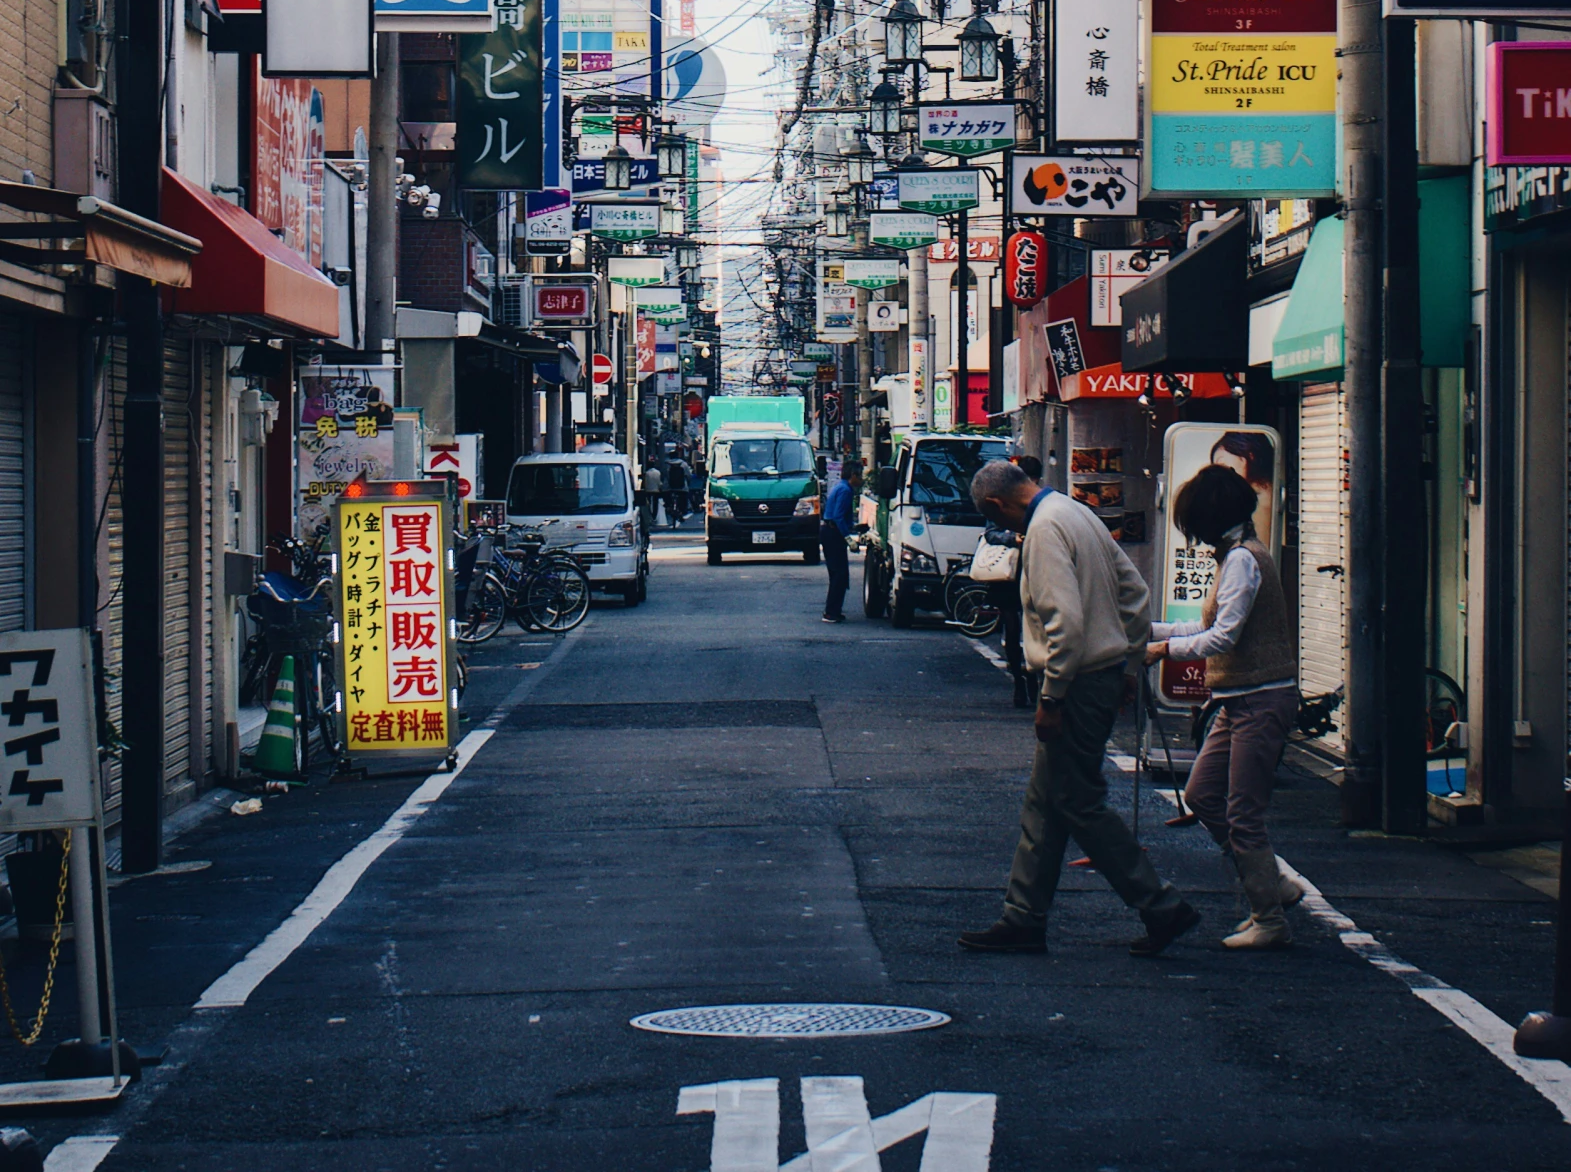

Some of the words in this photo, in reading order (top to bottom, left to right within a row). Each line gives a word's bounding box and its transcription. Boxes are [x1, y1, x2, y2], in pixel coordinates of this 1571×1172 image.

[1206, 7, 1283, 16] SHINSAIBASHI
[1192, 41, 1219, 51] Total
[1221, 41, 1268, 51] Treatment
[1272, 41, 1297, 51] salon
[1086, 26, 1110, 98] 心斎橋
[1277, 65, 1317, 80] ICU
[1015, 237, 1038, 300] たこ焼
[325, 396, 366, 411] bag
[316, 416, 378, 438] 免税
[319, 458, 376, 474] jewelry
[309, 483, 347, 495] DUTY
[389, 512, 437, 598] 買取
[391, 610, 440, 700] 販売
